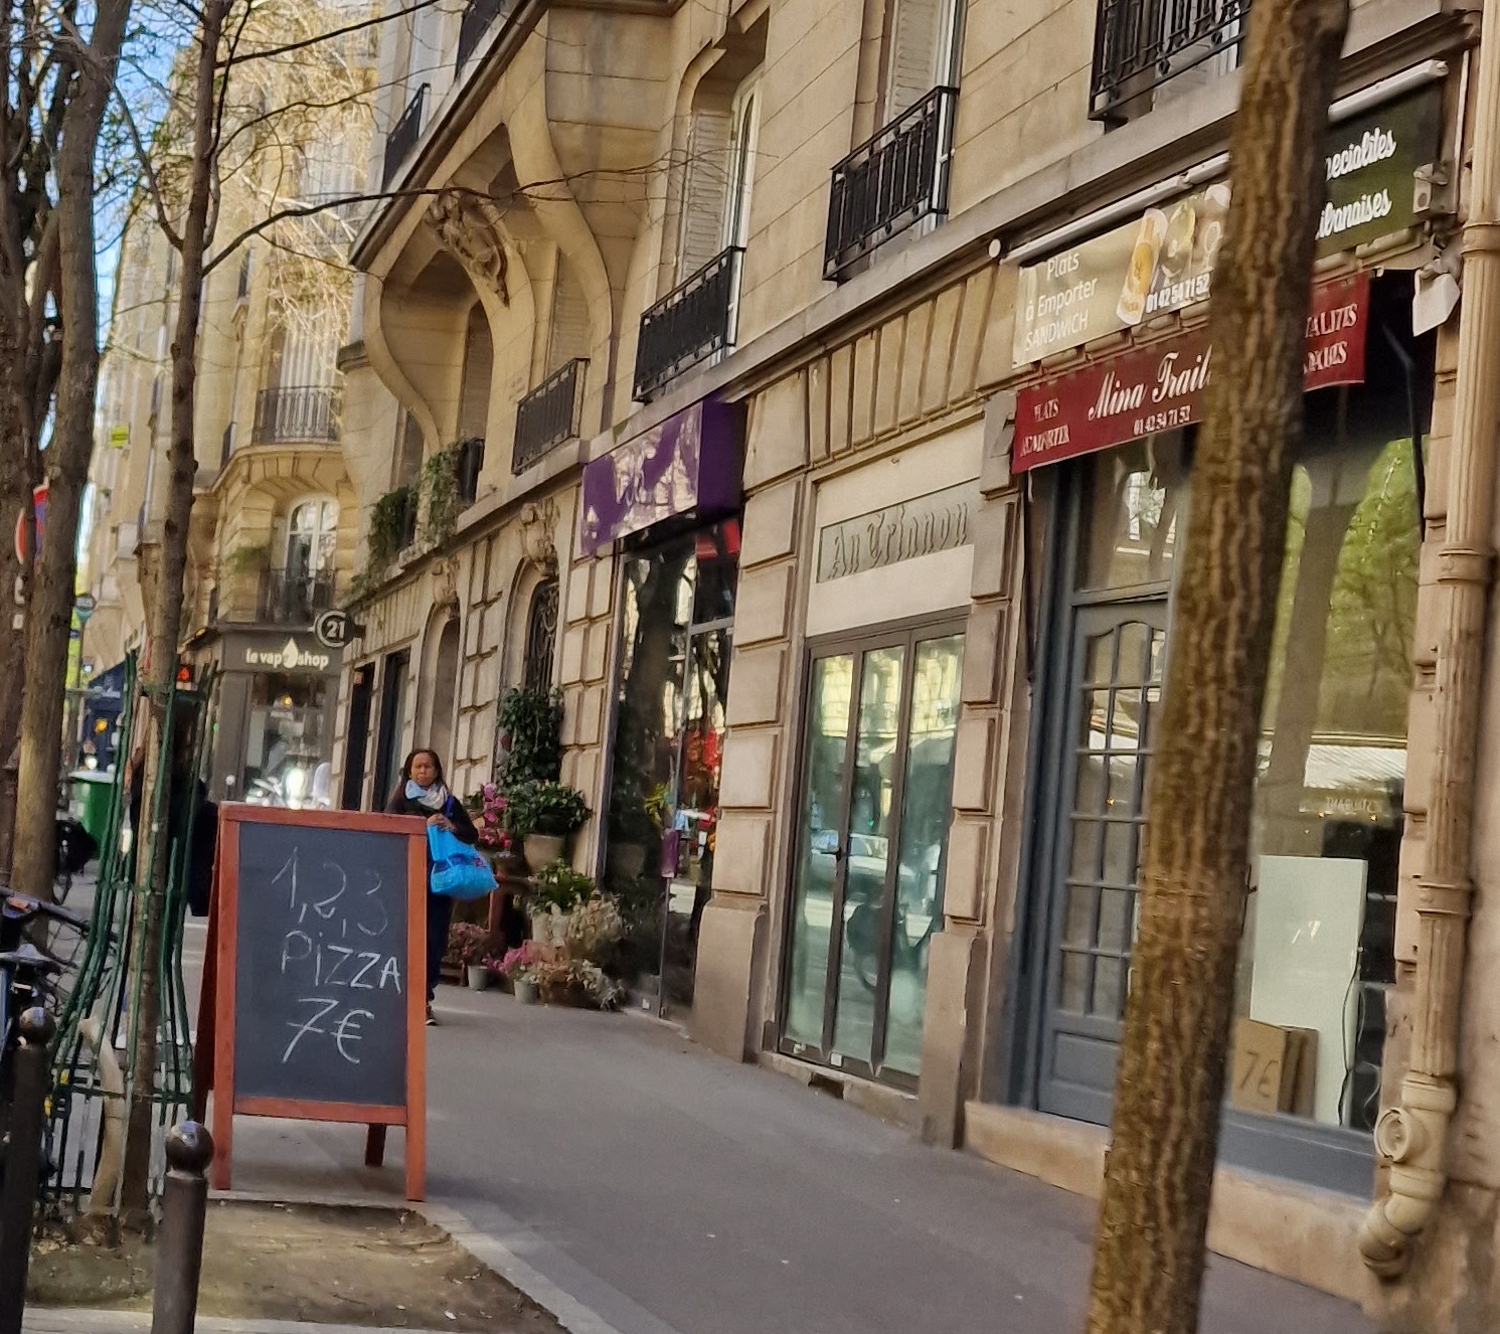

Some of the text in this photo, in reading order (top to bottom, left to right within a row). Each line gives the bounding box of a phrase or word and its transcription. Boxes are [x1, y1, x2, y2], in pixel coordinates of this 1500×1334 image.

[1046, 252, 1080, 281] Plats
[1037, 277, 1098, 318] Emporter
[1025, 309, 1088, 352] SANDWICH
[1088, 371, 1148, 421] Mina
[245, 647, 259, 664] le
[281, 997, 375, 1064] 7€
